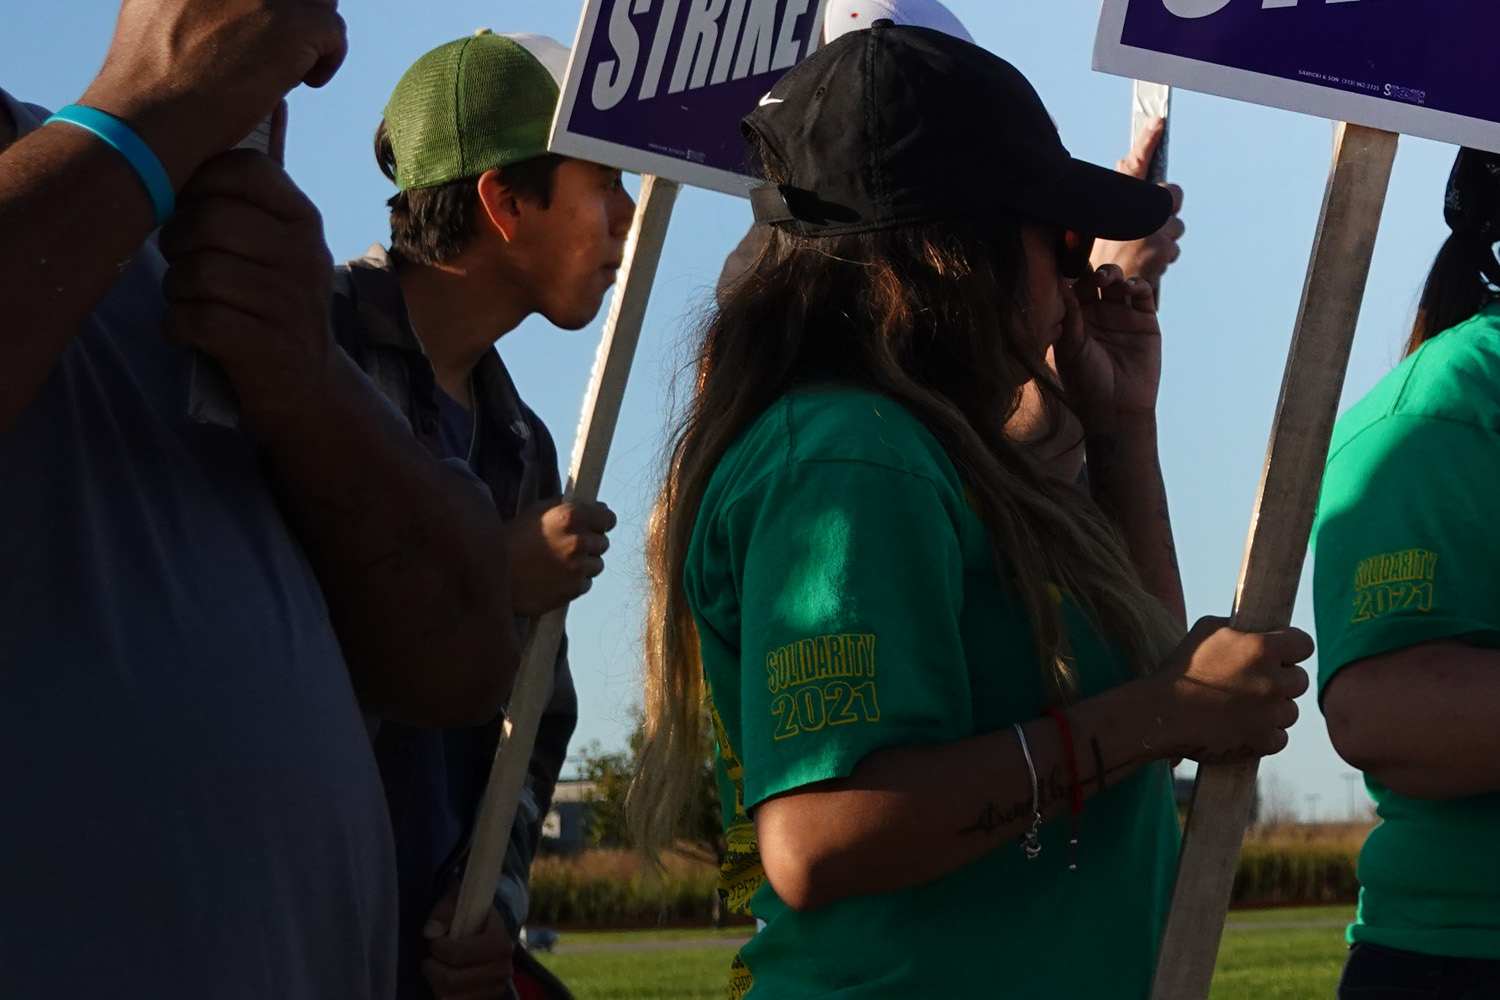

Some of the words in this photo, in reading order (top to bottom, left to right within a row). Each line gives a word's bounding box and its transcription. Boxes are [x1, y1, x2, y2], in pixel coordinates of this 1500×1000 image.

[1354, 549, 1438, 591] SOLIDARITY
[1351, 582, 1433, 623] 2021
[766, 634, 876, 694] SOLIDARITY
[771, 681, 881, 740] 2021
